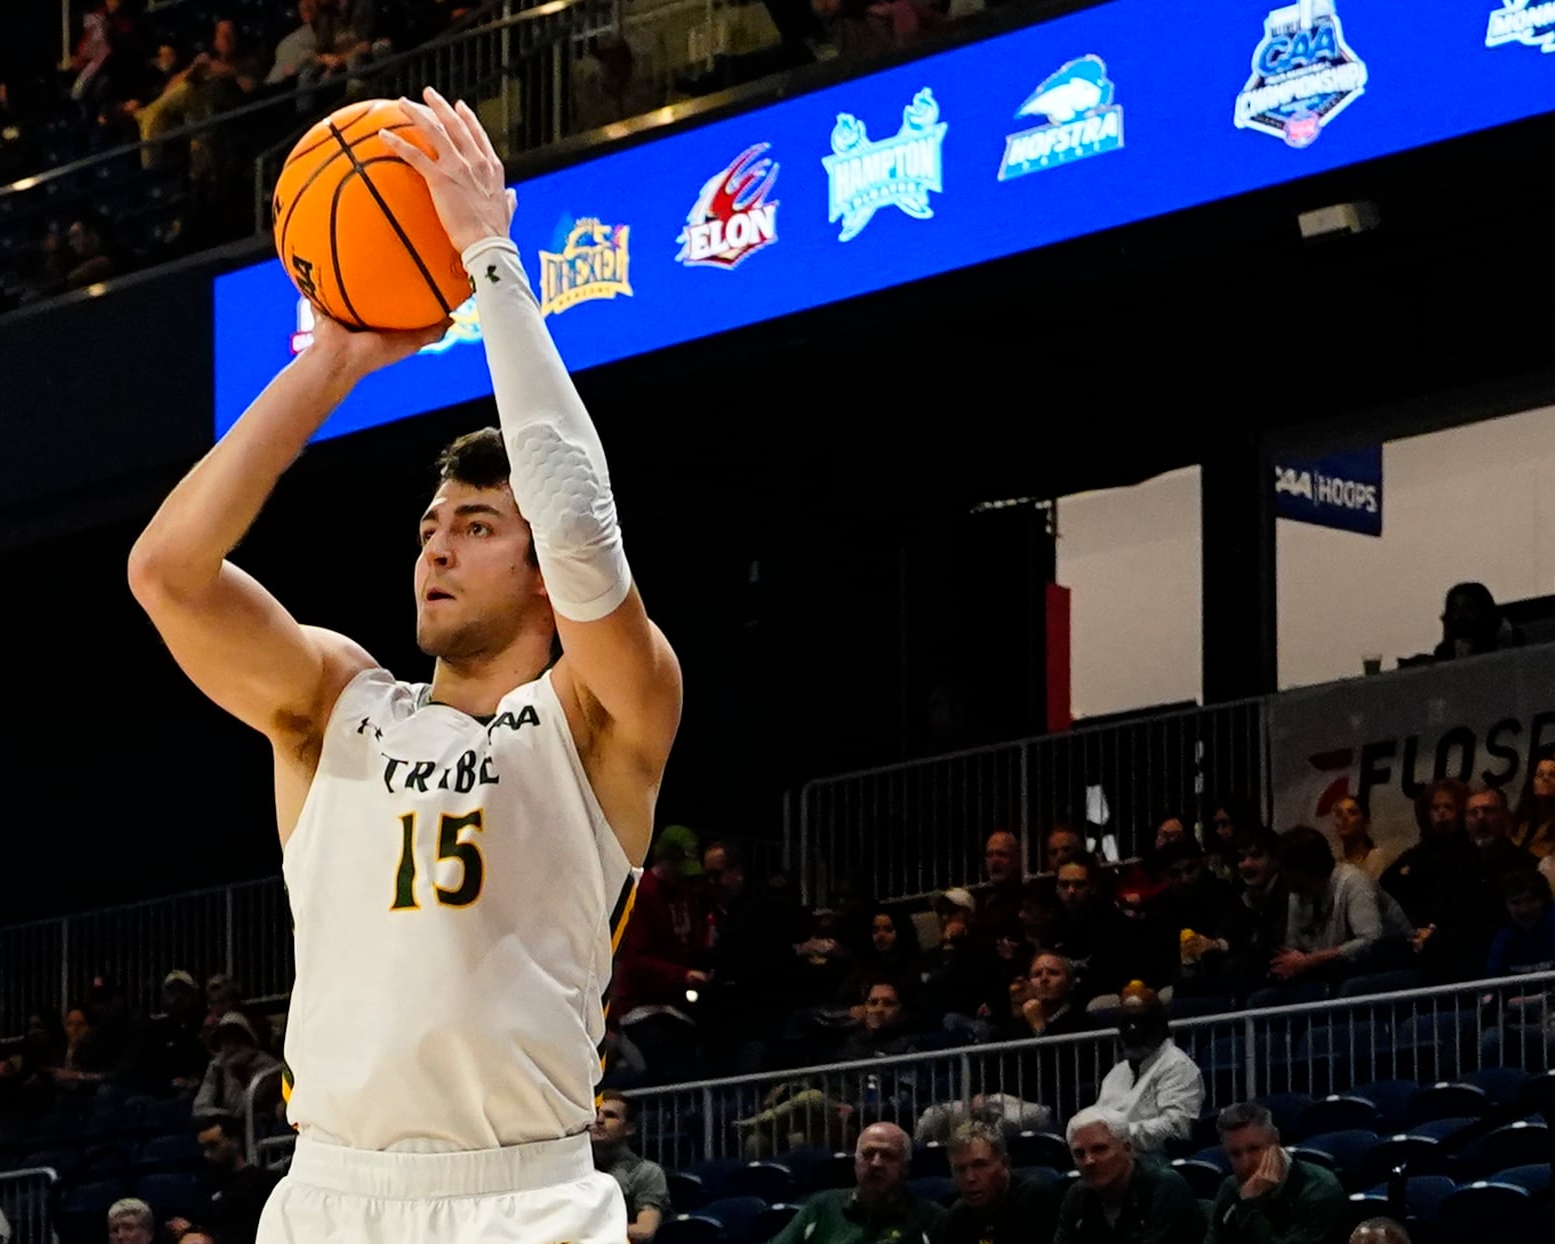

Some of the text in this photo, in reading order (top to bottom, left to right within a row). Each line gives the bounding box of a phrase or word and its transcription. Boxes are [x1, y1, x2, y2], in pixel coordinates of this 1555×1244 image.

[1258, 24, 1338, 76] CAA
[1007, 111, 1118, 166] HOFSTRA
[689, 204, 777, 261] ELON
[1318, 476, 1377, 513] HOOPS
[389, 807, 487, 913] 15
